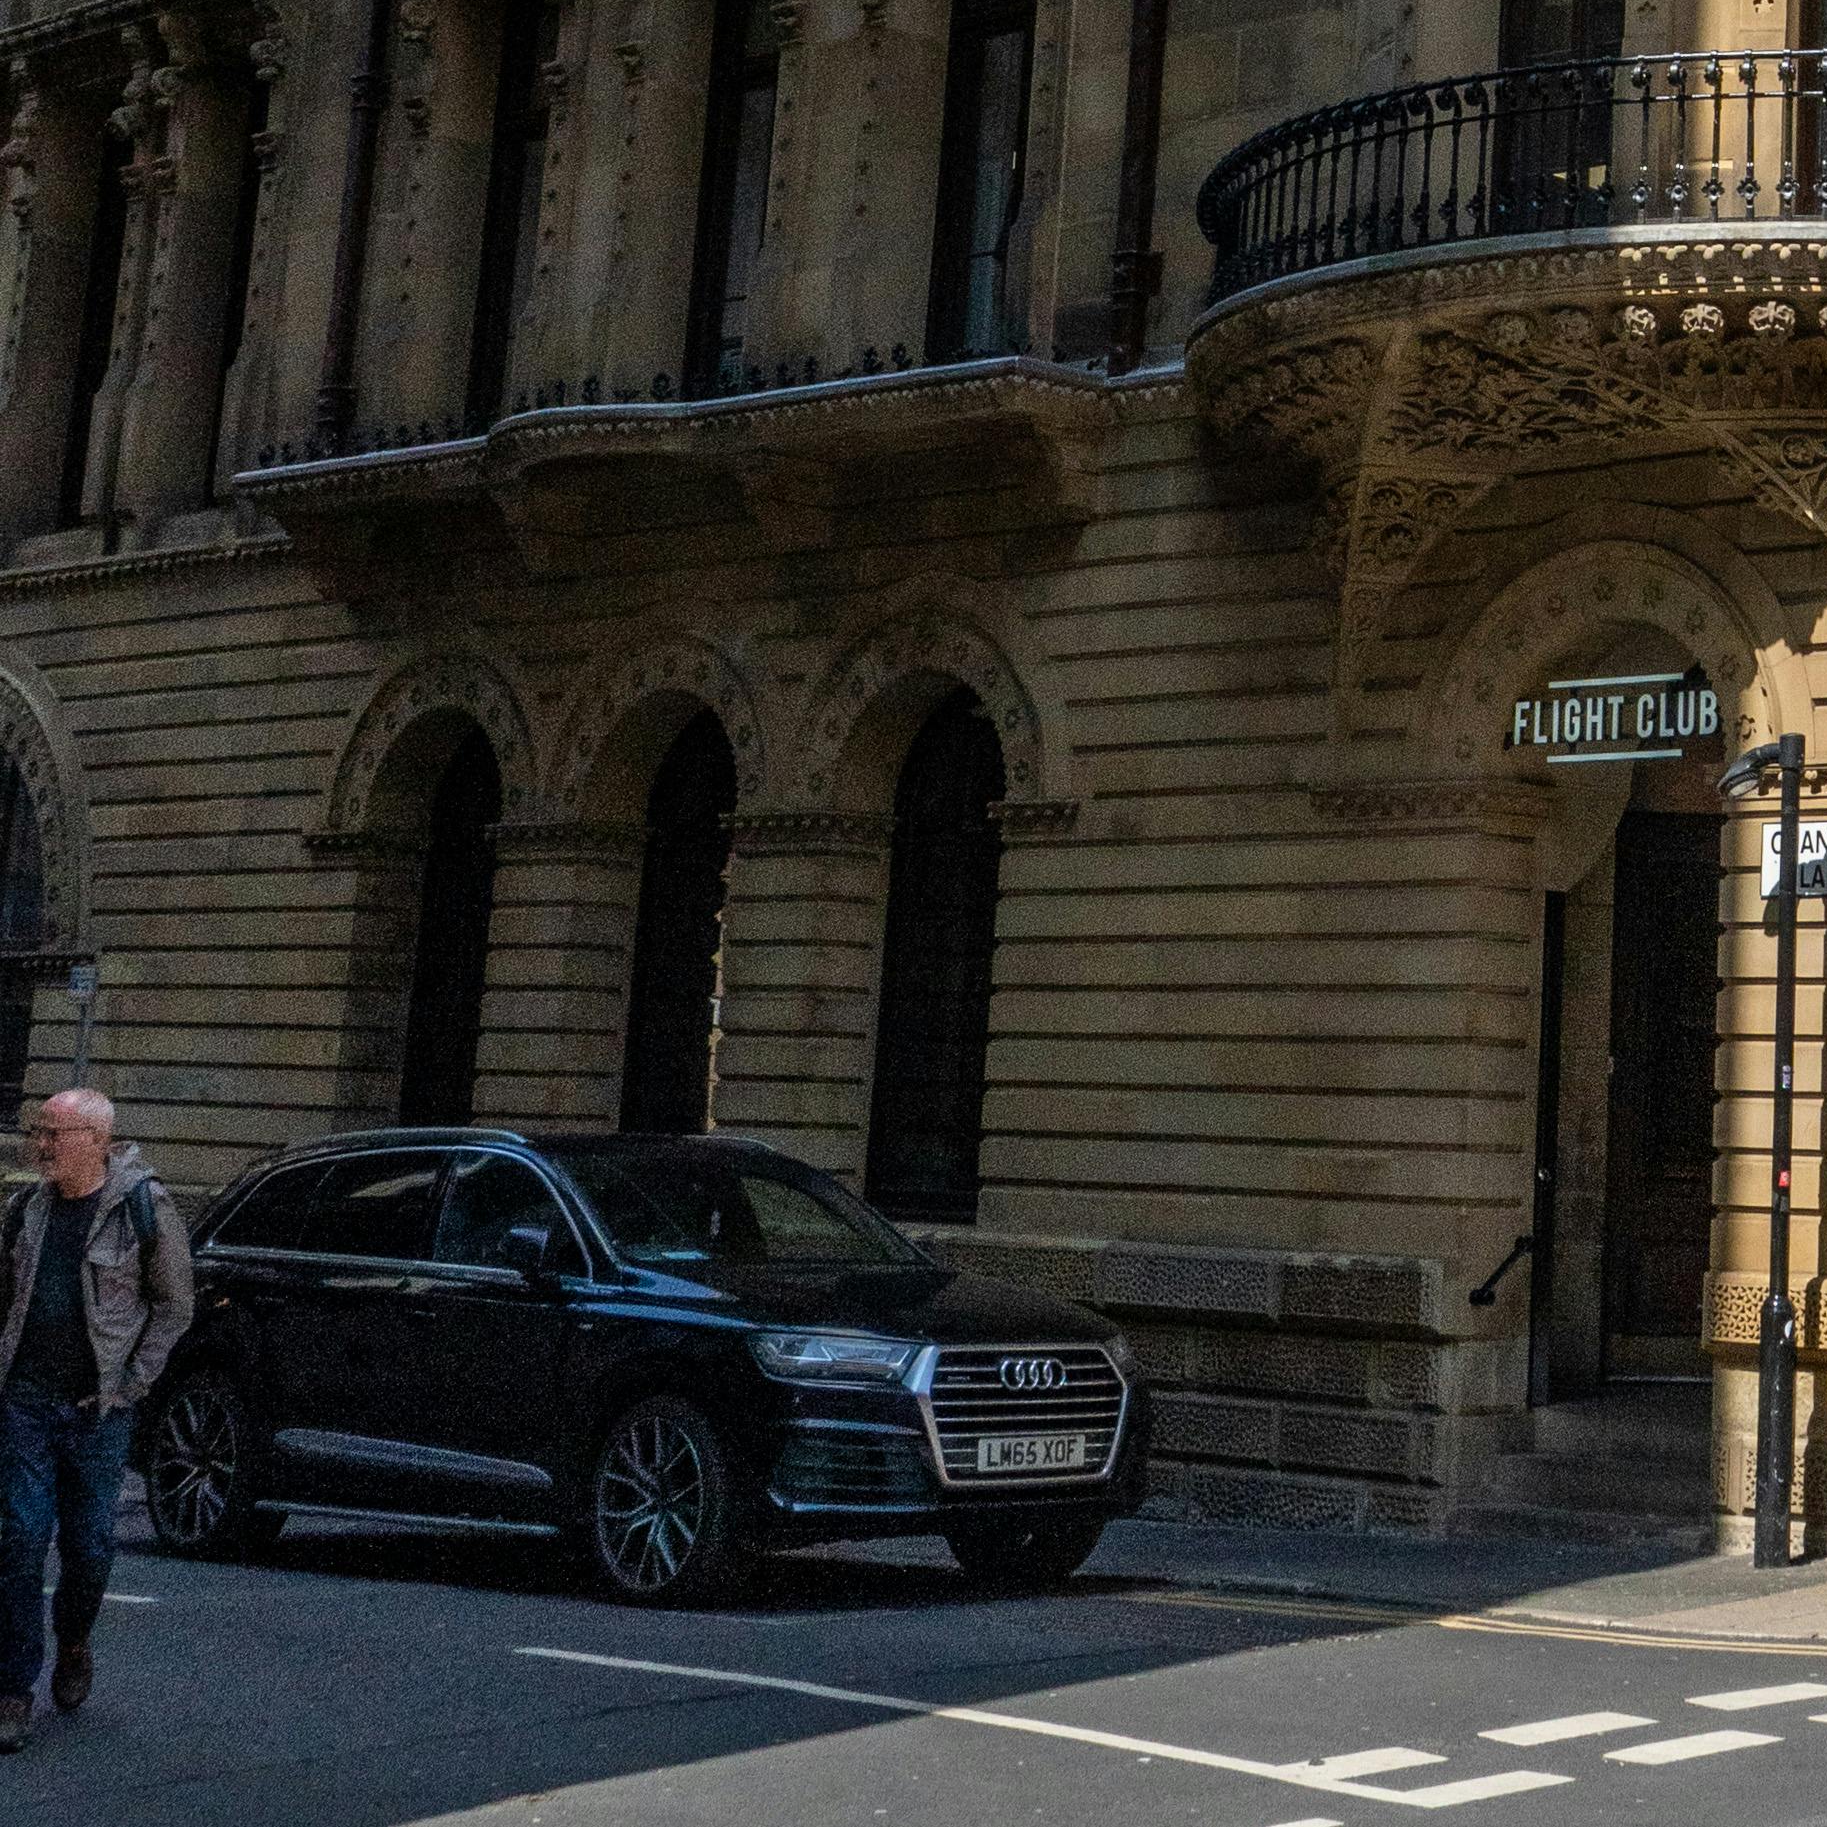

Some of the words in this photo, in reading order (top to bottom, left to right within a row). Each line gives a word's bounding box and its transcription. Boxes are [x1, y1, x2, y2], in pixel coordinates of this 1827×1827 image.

[1513, 695, 1624, 745] FLIGHT
[1636, 689, 1718, 739] CLUB
[1042, 1438, 1078, 1465] XOF
